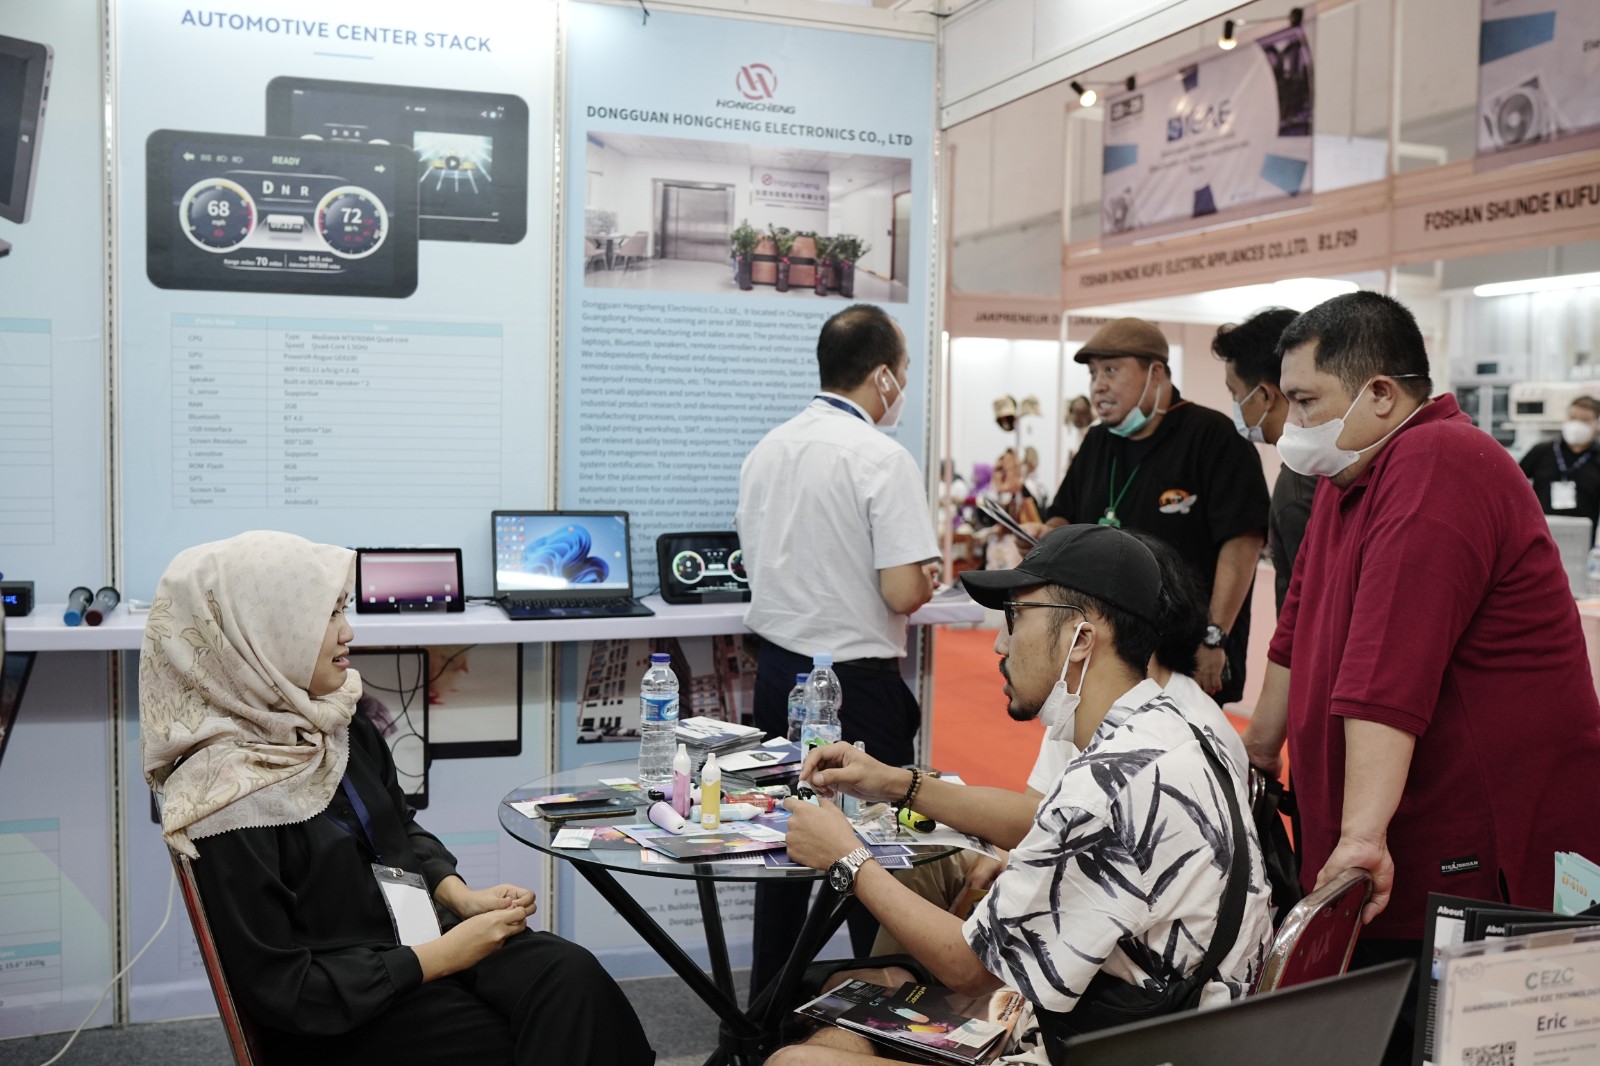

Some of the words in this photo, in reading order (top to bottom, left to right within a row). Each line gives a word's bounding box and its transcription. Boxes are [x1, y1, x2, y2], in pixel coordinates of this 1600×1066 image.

[181, 9, 330, 38] AUTOMOTIVE
[336, 24, 418, 46] CENTER
[423, 33, 493, 53] STACK
[716, 99, 796, 115] HONGCHENG
[587, 106, 670, 125] DONGGUAN
[673, 113, 763, 132] HONGCHENG
[765, 122, 856, 142] ELECTRONICS
[858, 130, 887, 147] CO.,
[888, 134, 914, 147] LTD
[272, 155, 301, 167] READY
[262, 180, 275, 195] D
[281, 185, 291, 196] N
[300, 185, 310, 197] R
[207, 200, 231, 217] 68
[341, 208, 363, 224] 72
[1424, 205, 1484, 232] FOSHAN
[1486, 192, 1552, 222] SHUNDE
[255, 257, 269, 267] 70
[188, 413, 221, 421] Bluetooth
[1437, 905, 1464, 917] About
[1486, 924, 1506, 935] Abou
[1524, 967, 1575, 991] CEZC
[1536, 1012, 1567, 1032] Eric
